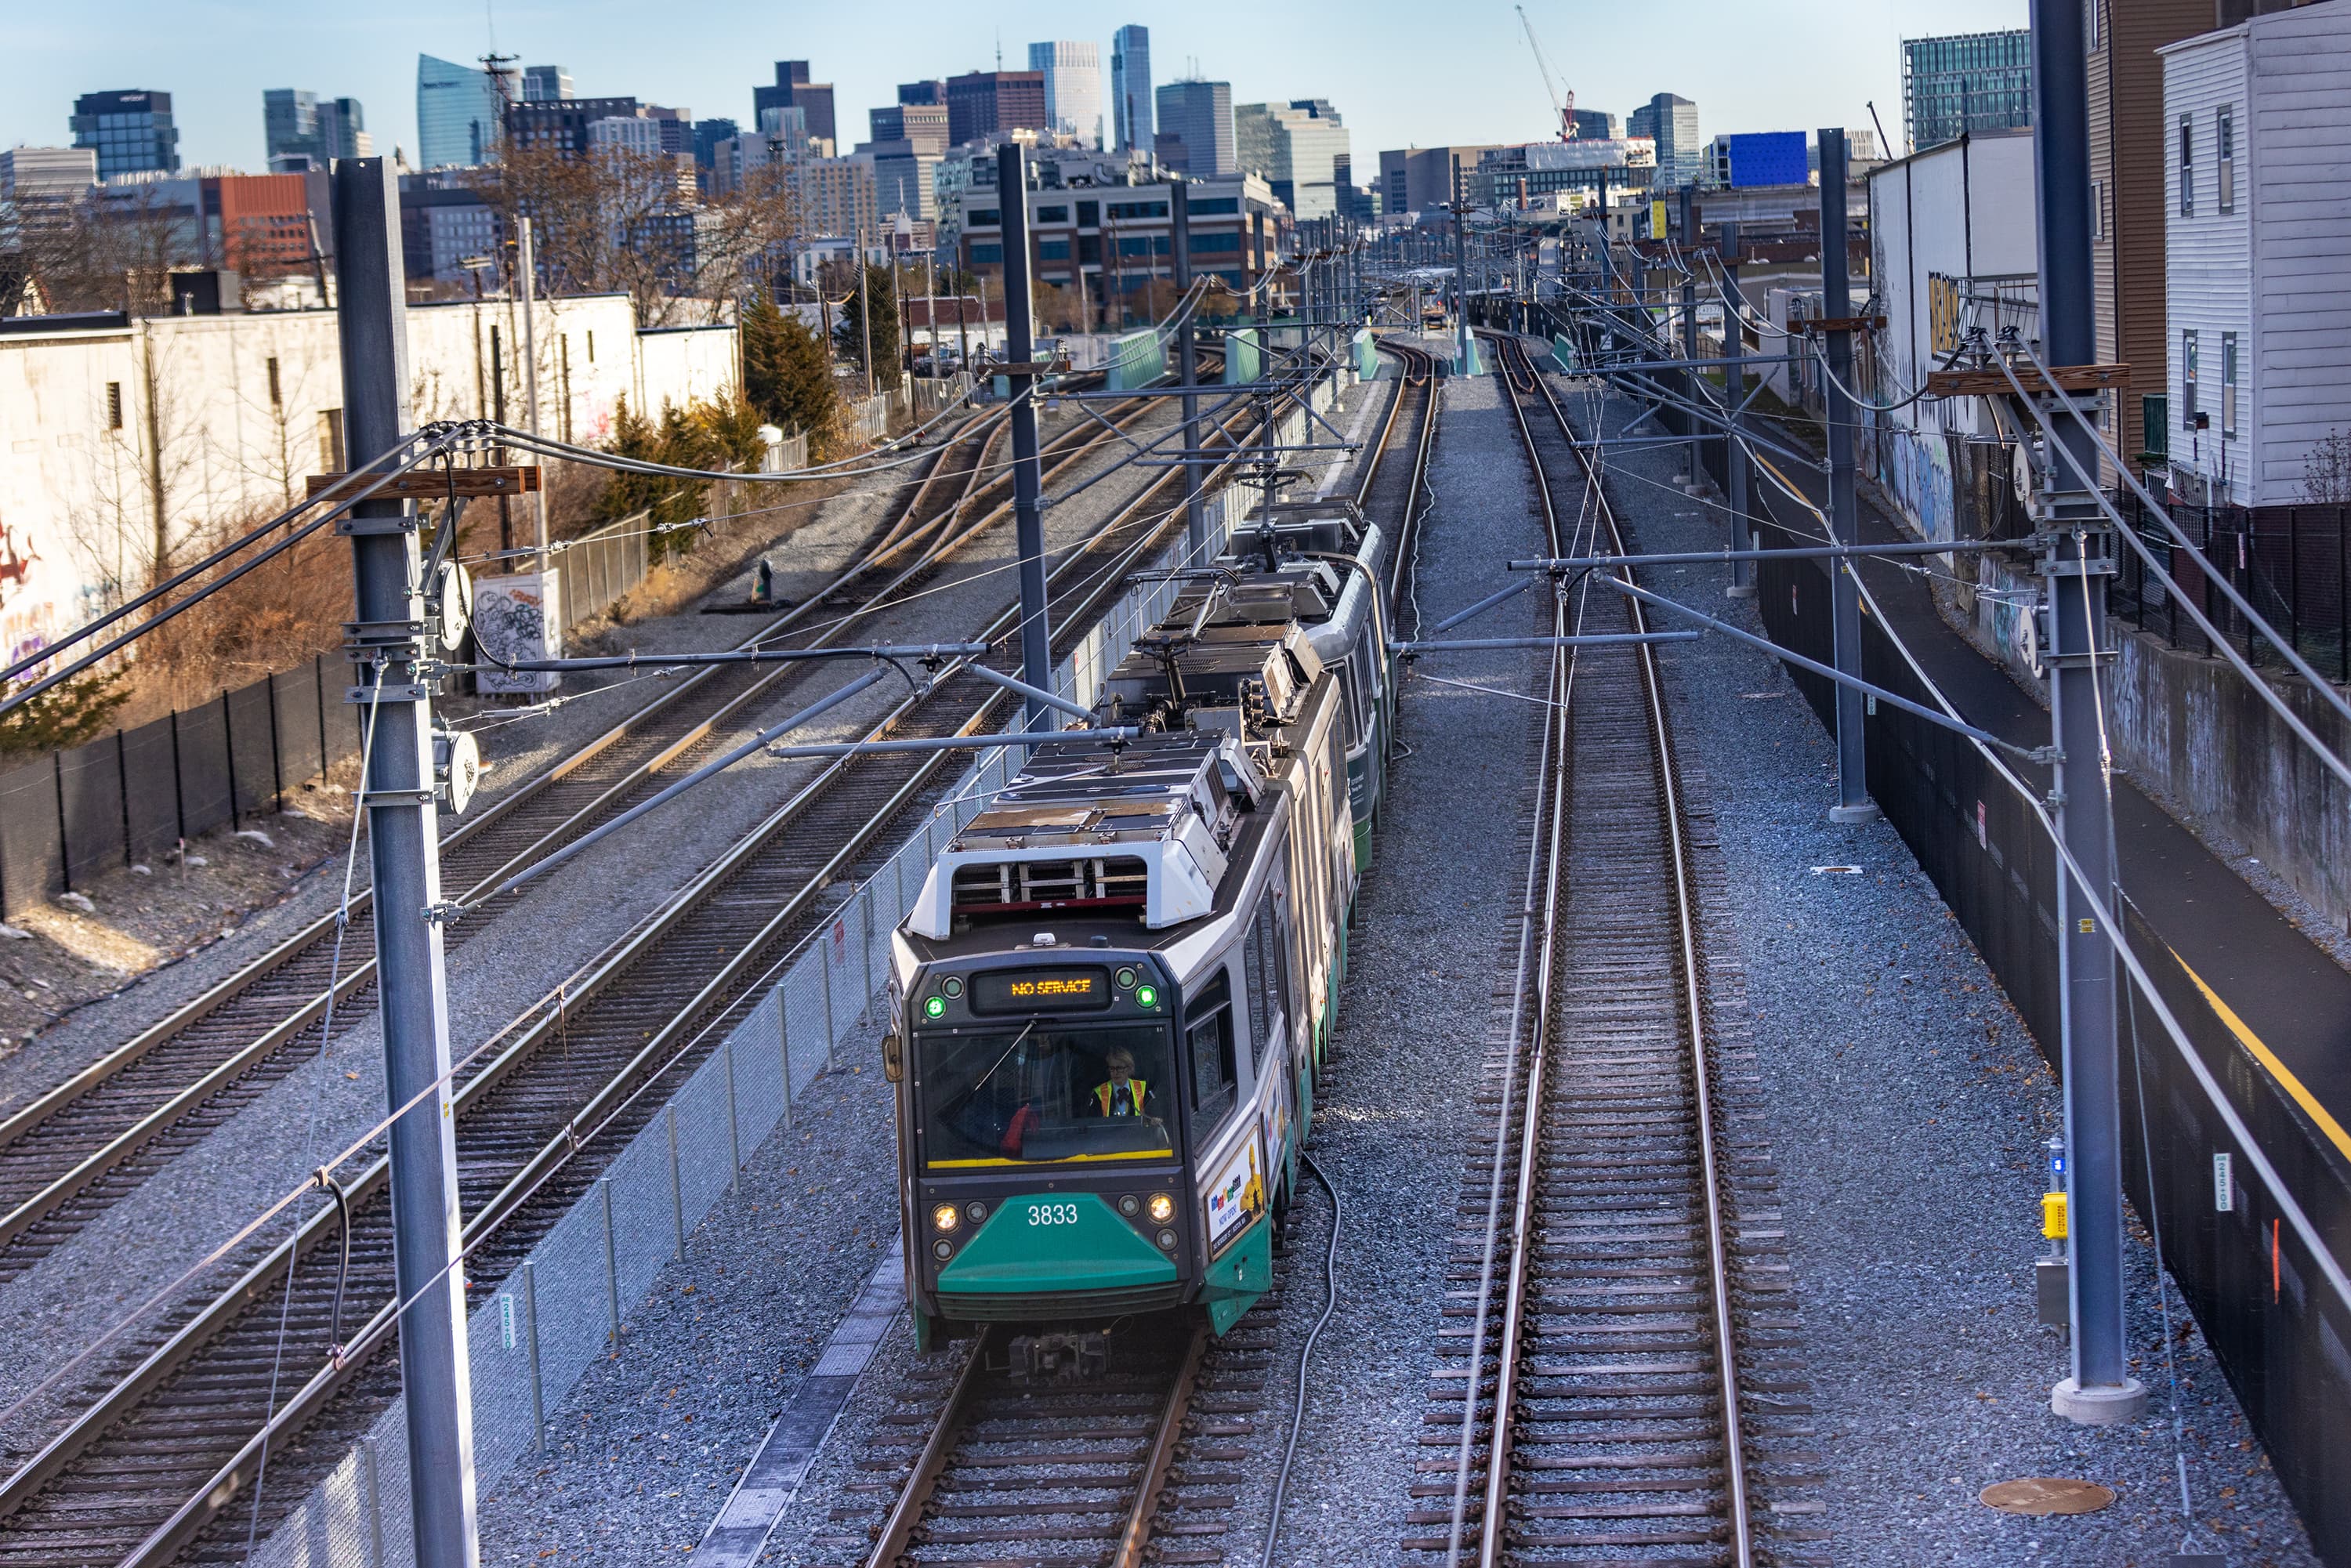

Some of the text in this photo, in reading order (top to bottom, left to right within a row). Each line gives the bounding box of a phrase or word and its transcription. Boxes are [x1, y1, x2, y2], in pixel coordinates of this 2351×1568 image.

[1012, 979, 1091, 996] NO SERVICE
[1028, 1204, 1078, 1226] 3833
